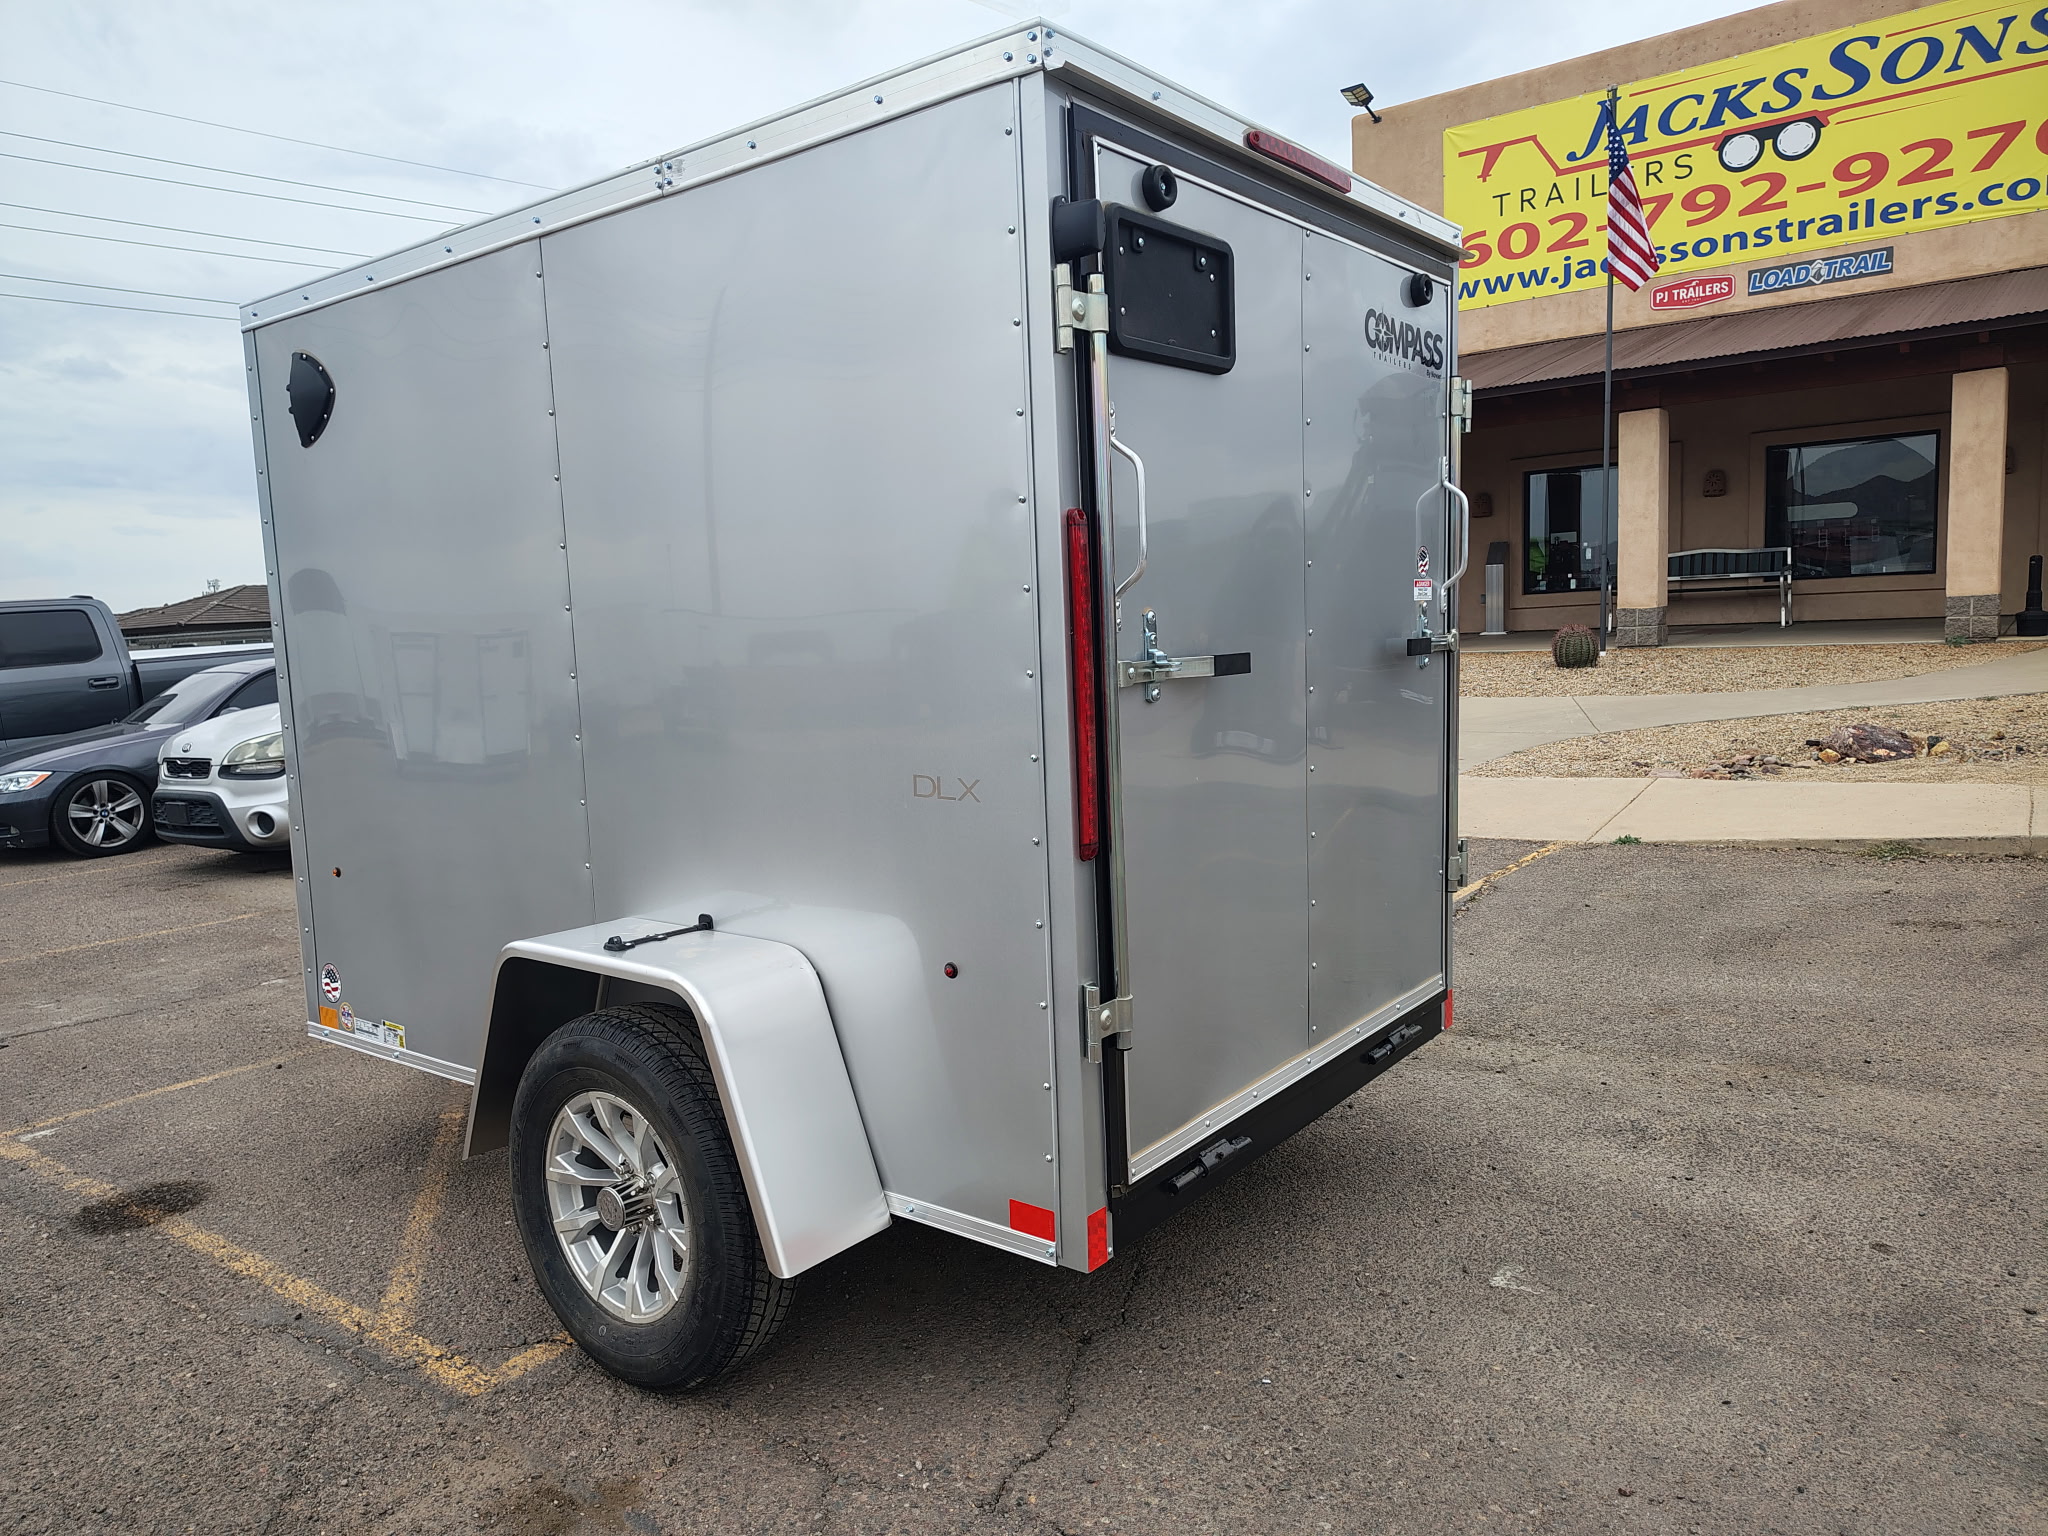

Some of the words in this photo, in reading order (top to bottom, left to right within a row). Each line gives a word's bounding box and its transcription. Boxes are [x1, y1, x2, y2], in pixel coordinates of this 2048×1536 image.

[1459, 119, 2048, 269] 602792-927
[1492, 154, 1693, 216] TRAILRS
[1458, 174, 2048, 300] www.jassonstrailers.co
[1656, 291, 1669, 303] PJ
[1672, 281, 1729, 300] TRAILERS
[1750, 266, 1811, 293] LOAD
[1823, 251, 1893, 278] TRAIL
[1364, 308, 1444, 370] COMPASS
[1373, 351, 1412, 370] TRAILERS
[912, 774, 981, 803] DLX
